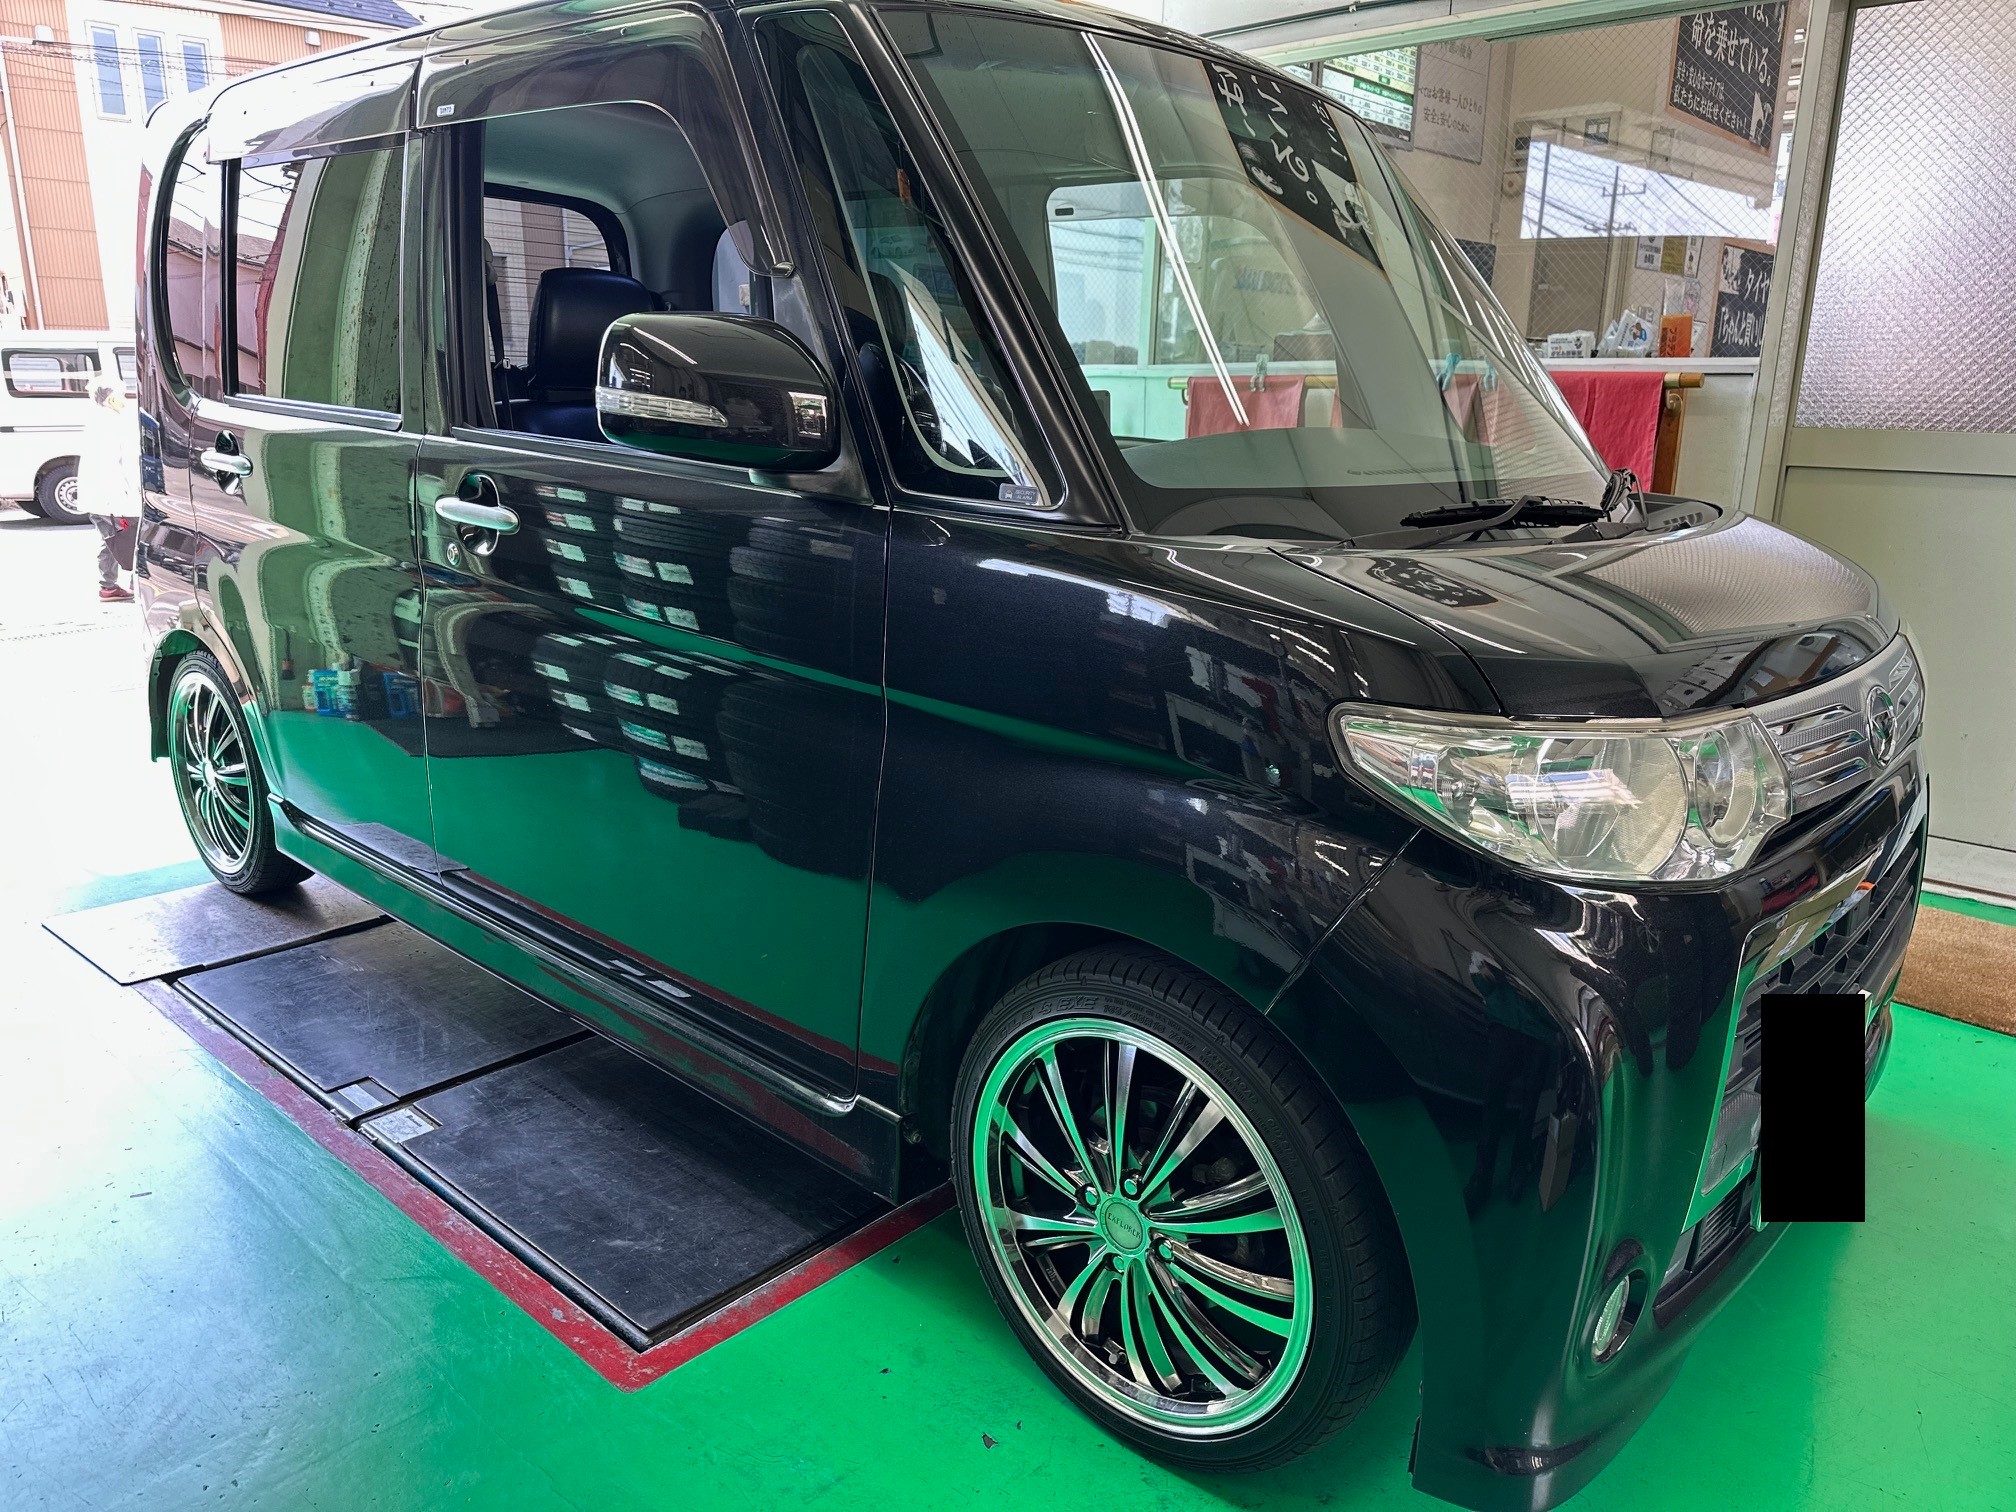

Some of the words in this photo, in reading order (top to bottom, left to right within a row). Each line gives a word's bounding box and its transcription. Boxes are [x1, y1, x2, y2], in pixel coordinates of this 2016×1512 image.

[1691, 12, 1772, 88] 命を乗せている。
